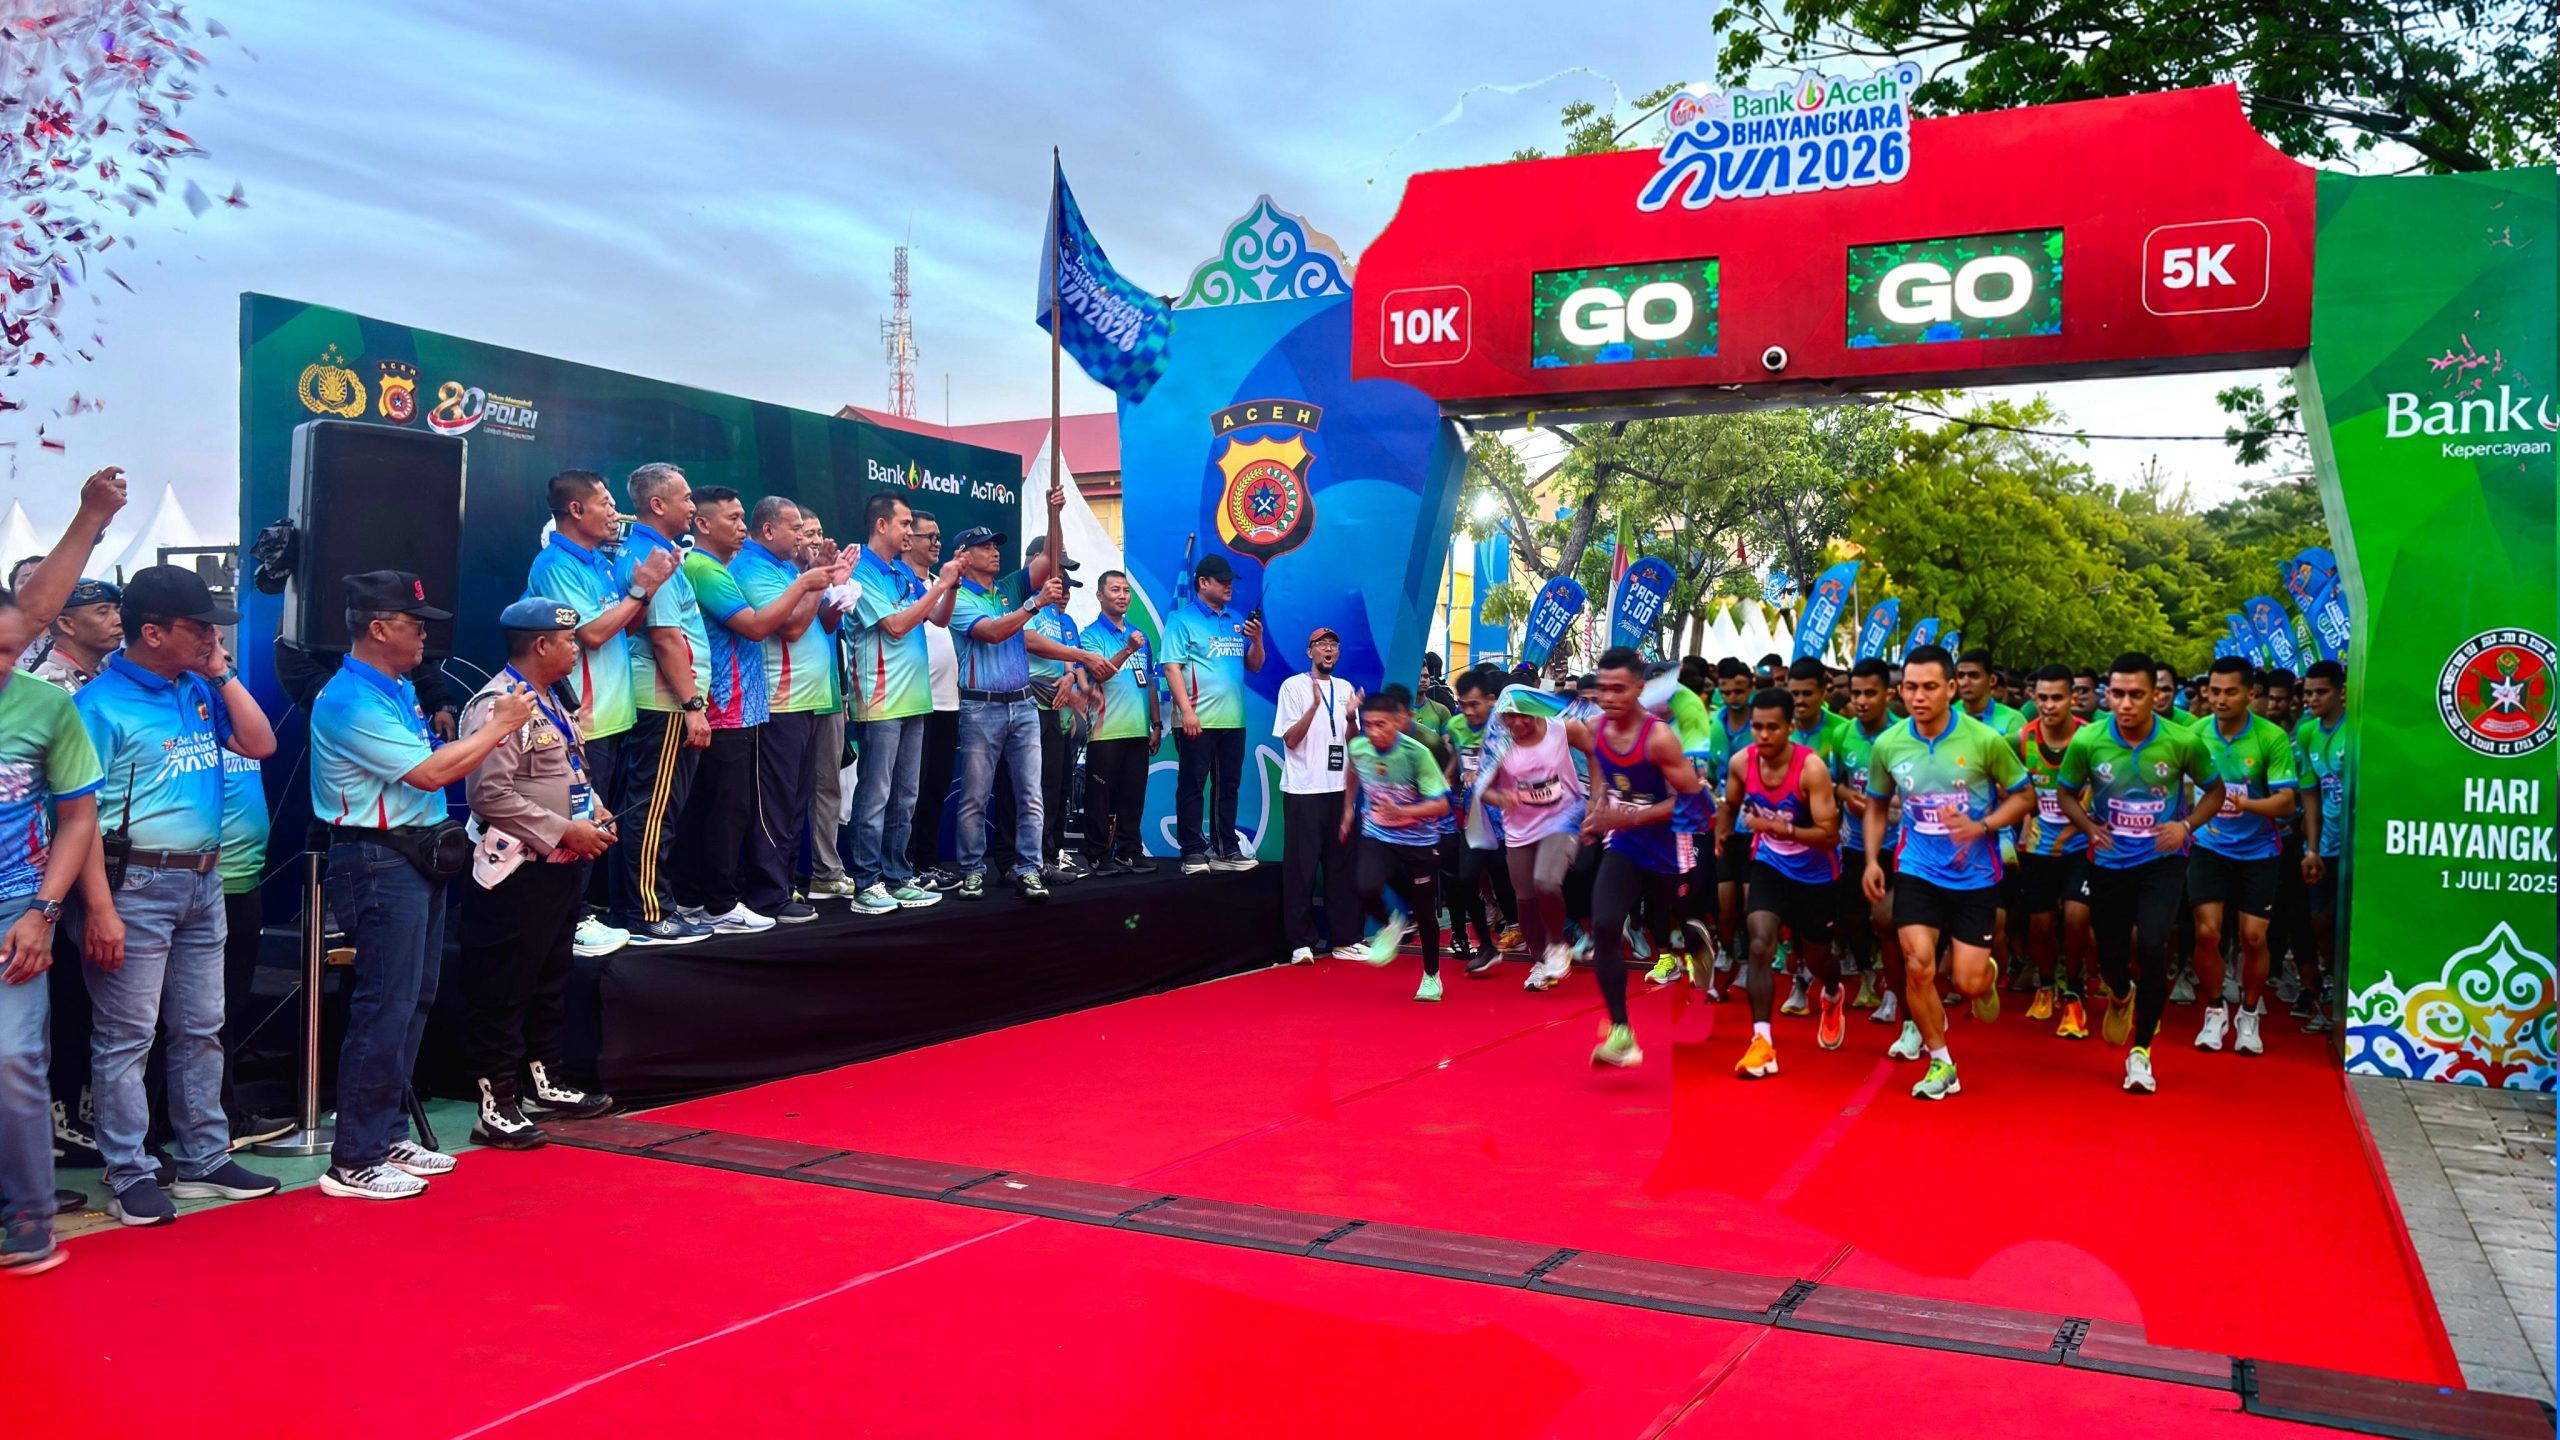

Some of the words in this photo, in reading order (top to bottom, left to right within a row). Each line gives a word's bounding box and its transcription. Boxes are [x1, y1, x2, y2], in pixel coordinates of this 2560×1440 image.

[1733, 90, 1796, 119] Bank
[1825, 75, 1898, 107] Aceh
[1732, 103, 1903, 146] BHAYANGKARA
[1797, 131, 1904, 186] 2026
[2162, 244, 2237, 289] 5K
[1878, 256, 2033, 324] GO
[1390, 306, 1460, 345] 10K
[1559, 282, 1694, 346] GO
[483, 402, 539, 429] POLRI
[1222, 406, 1311, 429] ACEH
[2385, 384, 2534, 438] Bank
[2442, 441, 2551, 459] Kepercayaan
[868, 459, 906, 486] Bank
[922, 469, 960, 495] Aceh
[1543, 599, 1571, 624] PACE
[1621, 594, 1653, 625] 5.00
[1629, 583, 1661, 609] PACE
[1535, 609, 1563, 638] 5.00
[2464, 777, 2540, 815] HARI
[2385, 820, 2557, 862] BHAYANGK
[2441, 870, 2450, 888] 1
[2455, 871, 2501, 891] JULI
[2507, 872, 2557, 894] 2025
